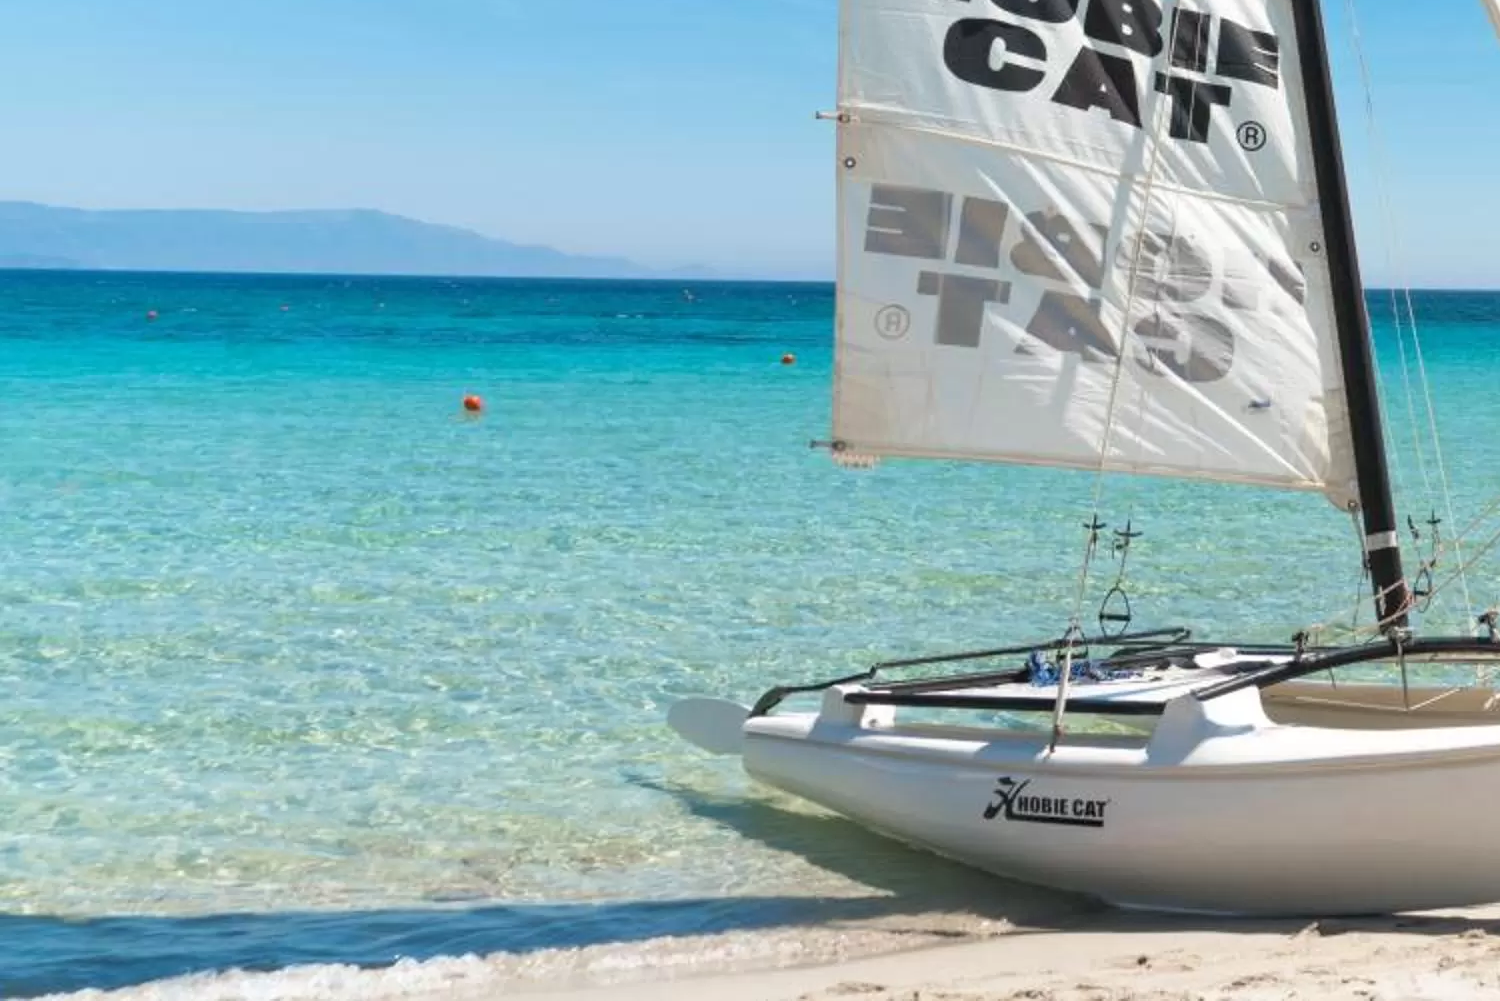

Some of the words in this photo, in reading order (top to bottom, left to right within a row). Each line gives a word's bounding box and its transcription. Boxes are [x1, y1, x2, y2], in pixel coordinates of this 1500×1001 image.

[943, 17, 1232, 143] CAT
[1017, 795, 1069, 815] HOBIE
[1072, 798, 1108, 817] CAT
